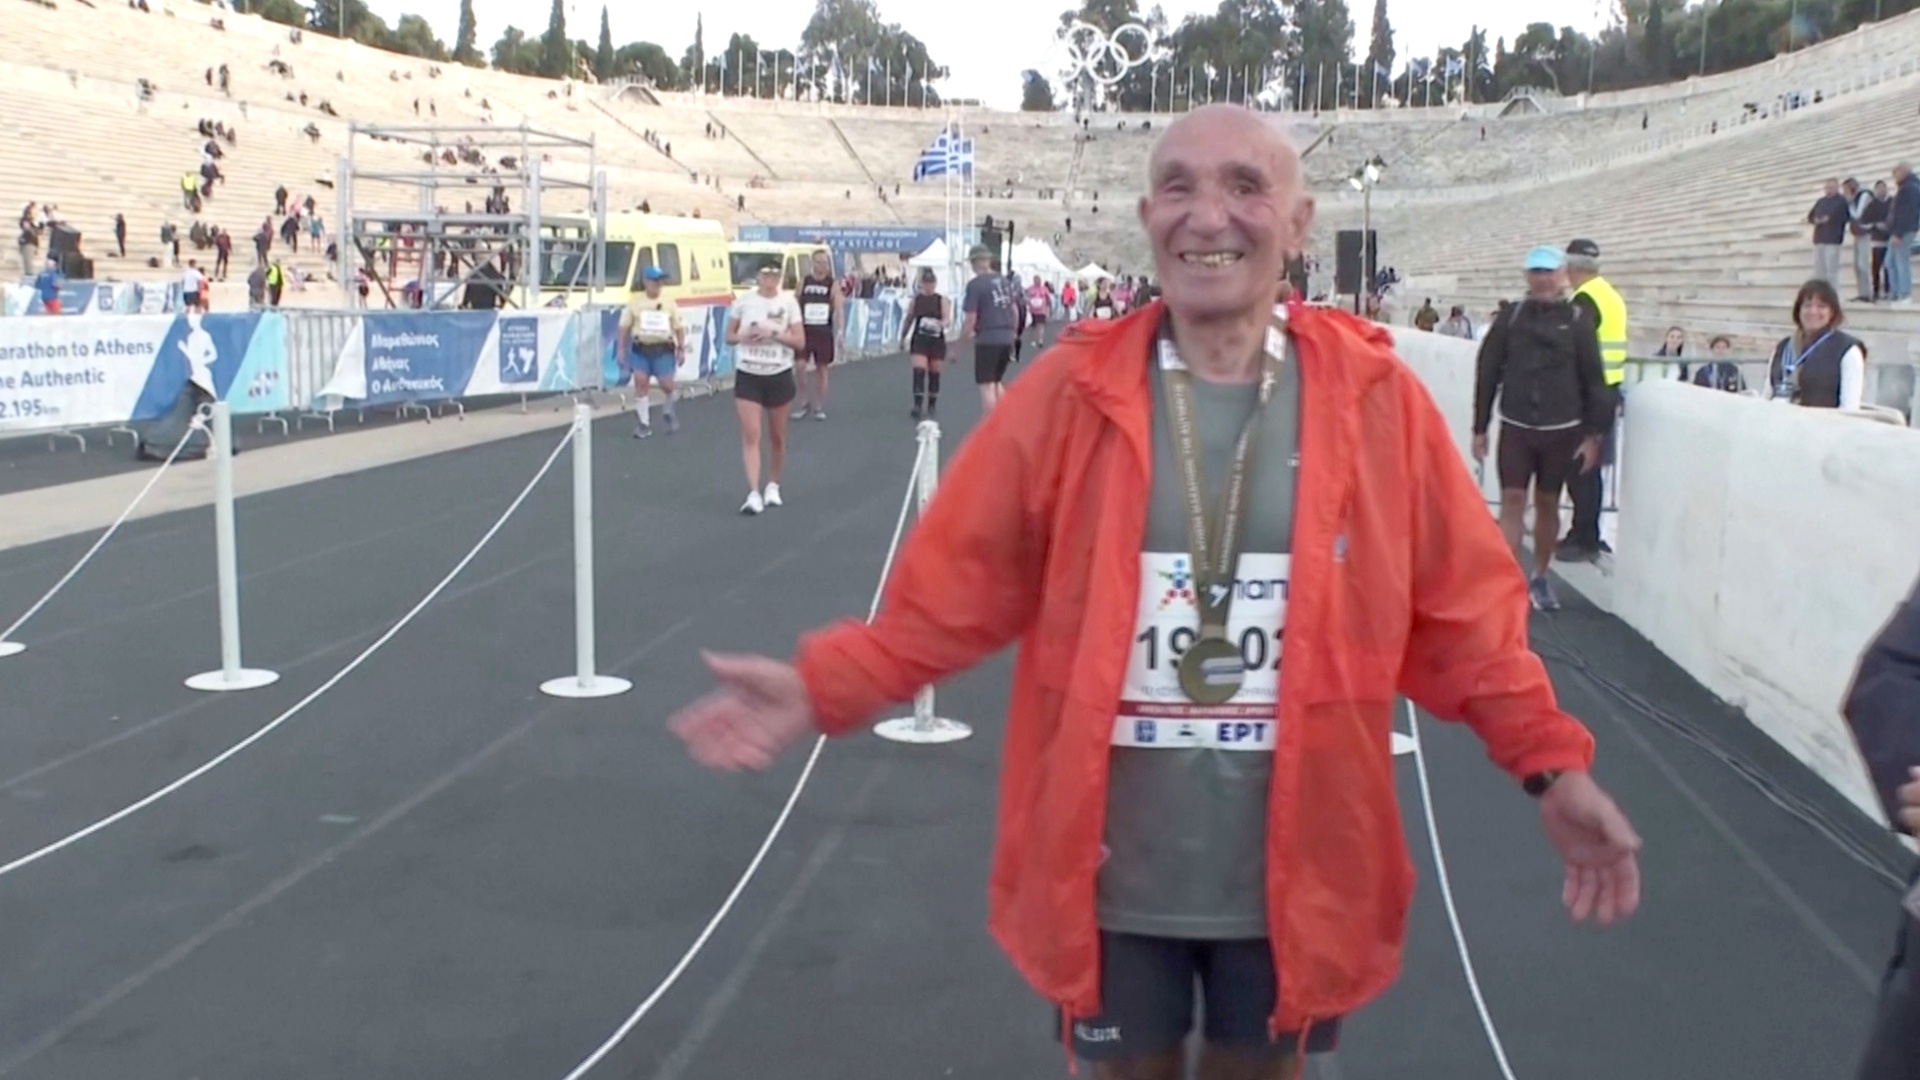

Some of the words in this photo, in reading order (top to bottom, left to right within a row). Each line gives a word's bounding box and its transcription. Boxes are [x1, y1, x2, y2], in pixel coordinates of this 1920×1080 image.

[71, 341, 89, 357] to
[94, 338, 154, 356] Athens
[21, 366, 105, 388] Authentic
